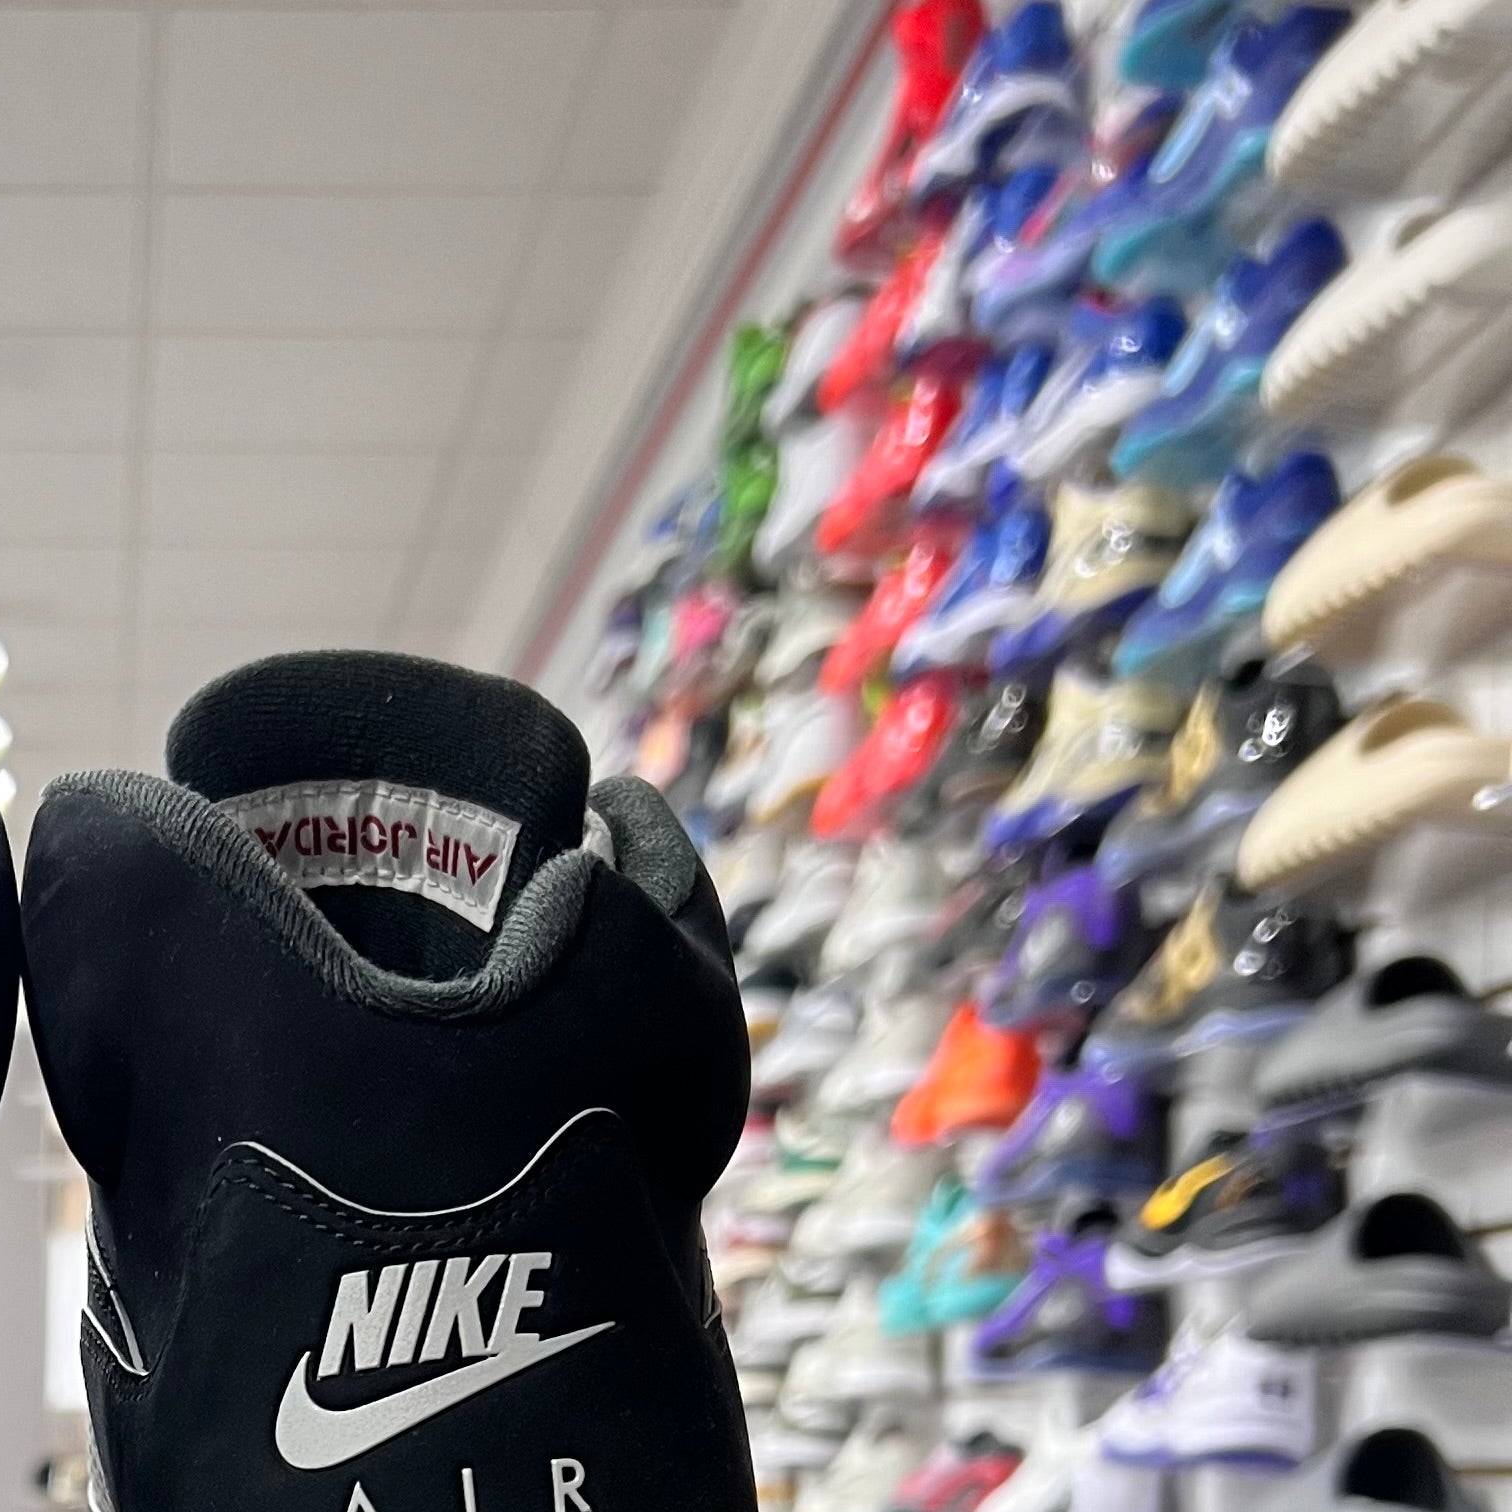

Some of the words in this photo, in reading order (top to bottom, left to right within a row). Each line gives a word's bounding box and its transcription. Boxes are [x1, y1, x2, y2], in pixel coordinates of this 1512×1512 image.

[254, 814, 418, 860] JORDA
[426, 827, 499, 887] AIR
[316, 1251, 553, 1381] NIKE
